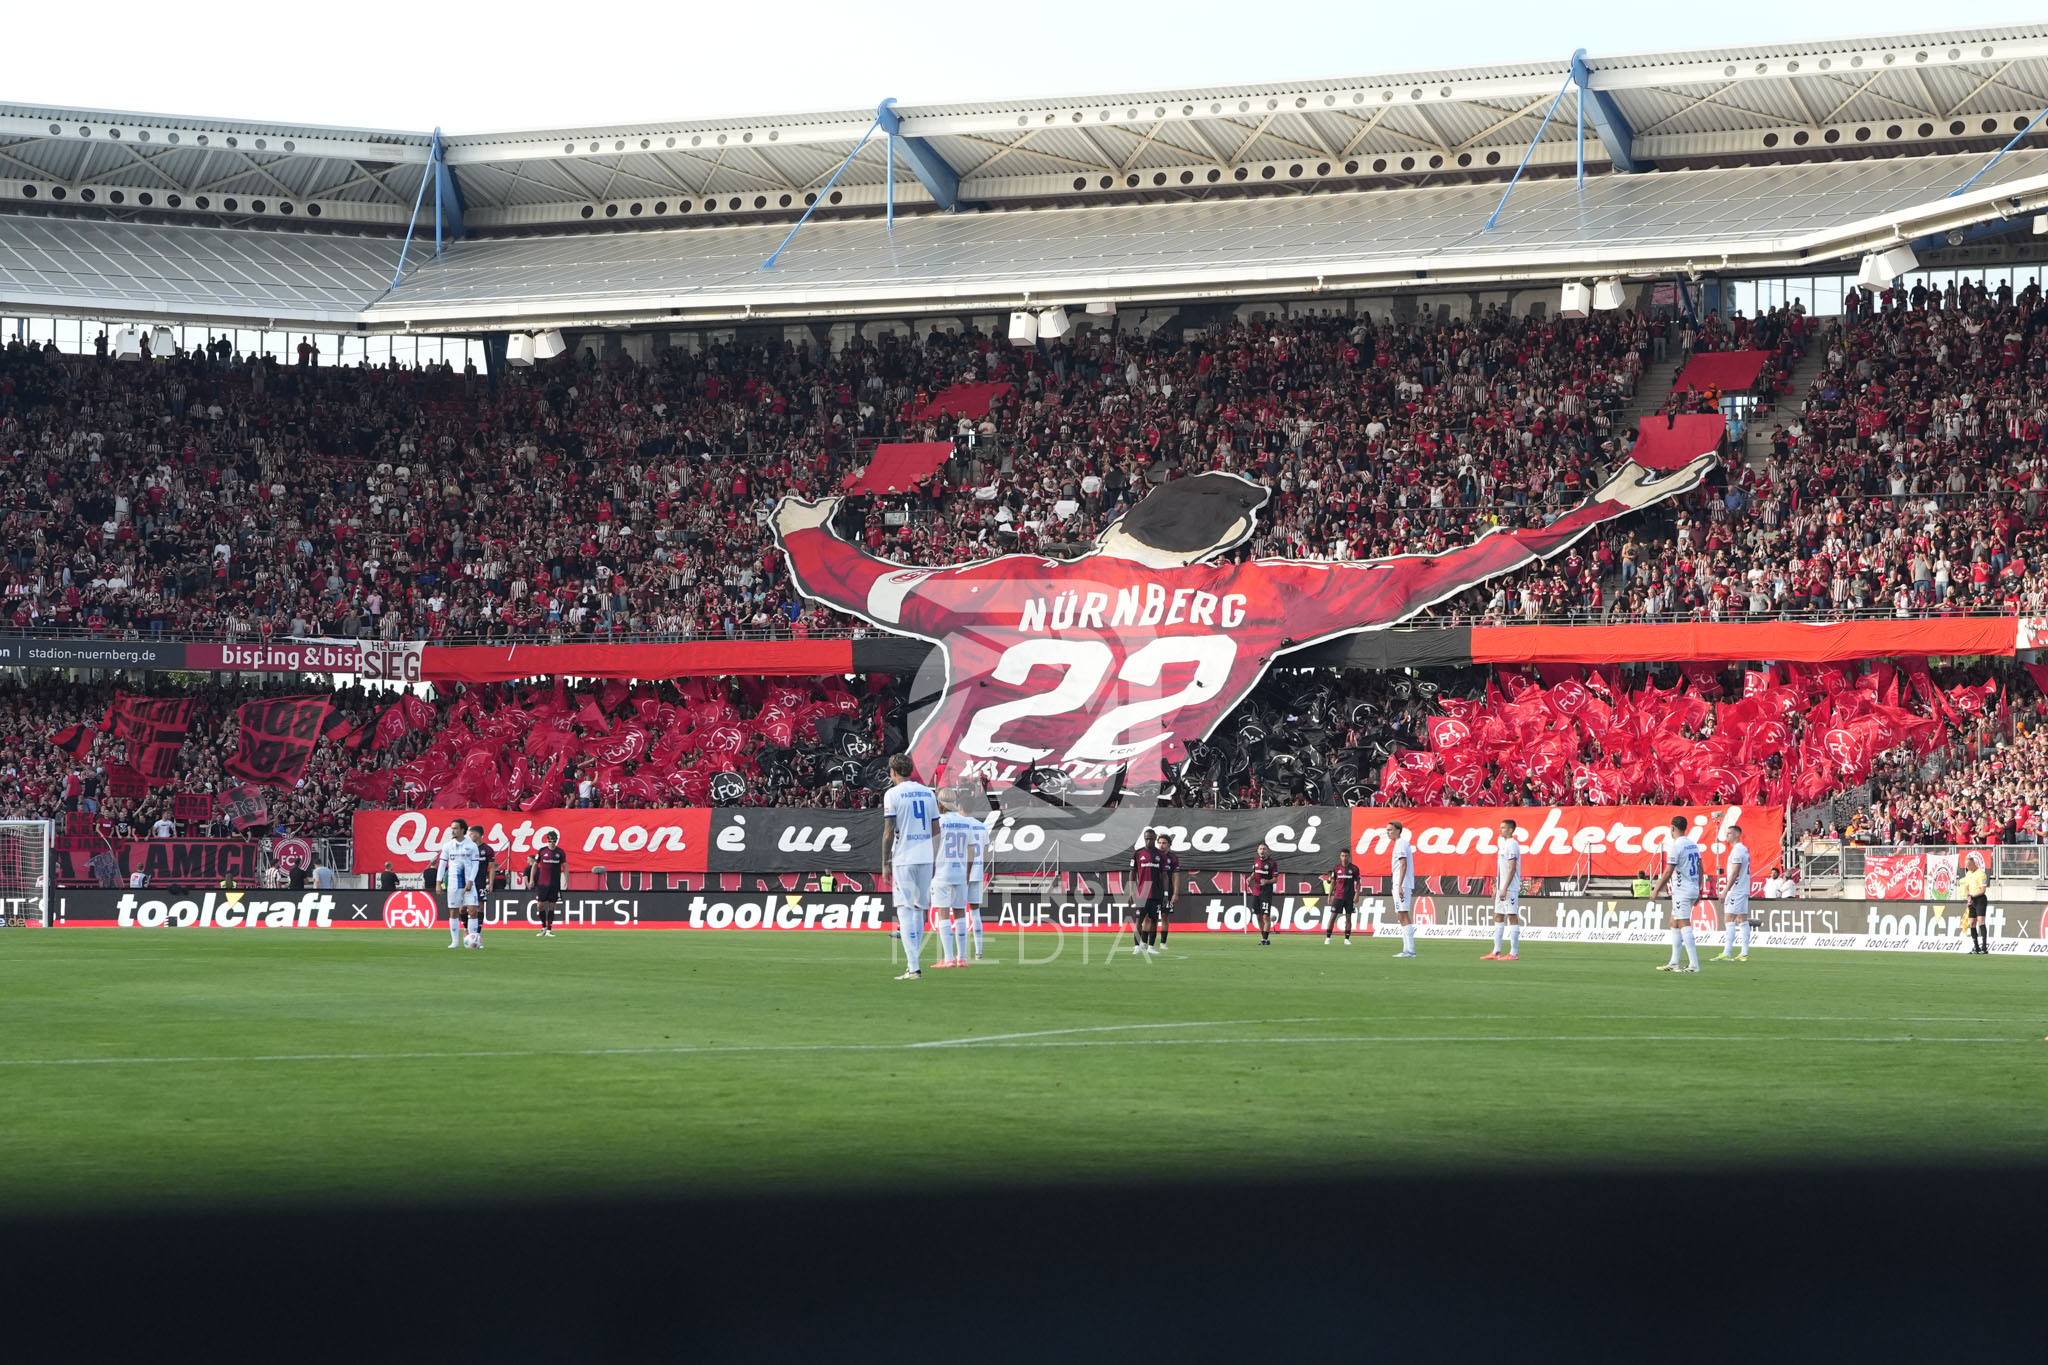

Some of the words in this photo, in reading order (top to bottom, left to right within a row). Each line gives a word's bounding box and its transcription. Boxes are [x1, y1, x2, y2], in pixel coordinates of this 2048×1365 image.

[1018, 583, 1247, 632] NÜRNBERG
[29, 648, 157, 663] stadion-nuernberg.de
[222, 645, 300, 670] bisping
[363, 651, 420, 681] SIEG
[958, 634, 1238, 764] 22
[913, 800, 926, 831] 4
[386, 811, 561, 863] Qusto
[583, 825, 686, 852] non
[716, 814, 747, 851] è
[778, 825, 852, 852] un
[1134, 825, 1231, 852] ma
[1264, 815, 1321, 853] ci
[945, 832, 967, 859] 20
[116, 892, 336, 928] toolcraft
[390, 909, 431, 928] FCN
[687, 895, 886, 930] toolcraft
[998, 903, 1052, 928] AUF
[1205, 897, 1387, 931] toolcraft
[1556, 901, 1664, 930] toolcraft
[1867, 904, 2007, 938] toolcrft
[1425, 928, 1462, 937] toolcraft
[1588, 932, 1623, 941] toolcraft
[1627, 932, 1666, 942] toolcraft
[1766, 936, 1807, 946] toolcraft
[1814, 937, 1857, 948] toolcraft
[1864, 937, 1909, 949] toolcraft
[1917, 939, 1963, 951] toolcraft
